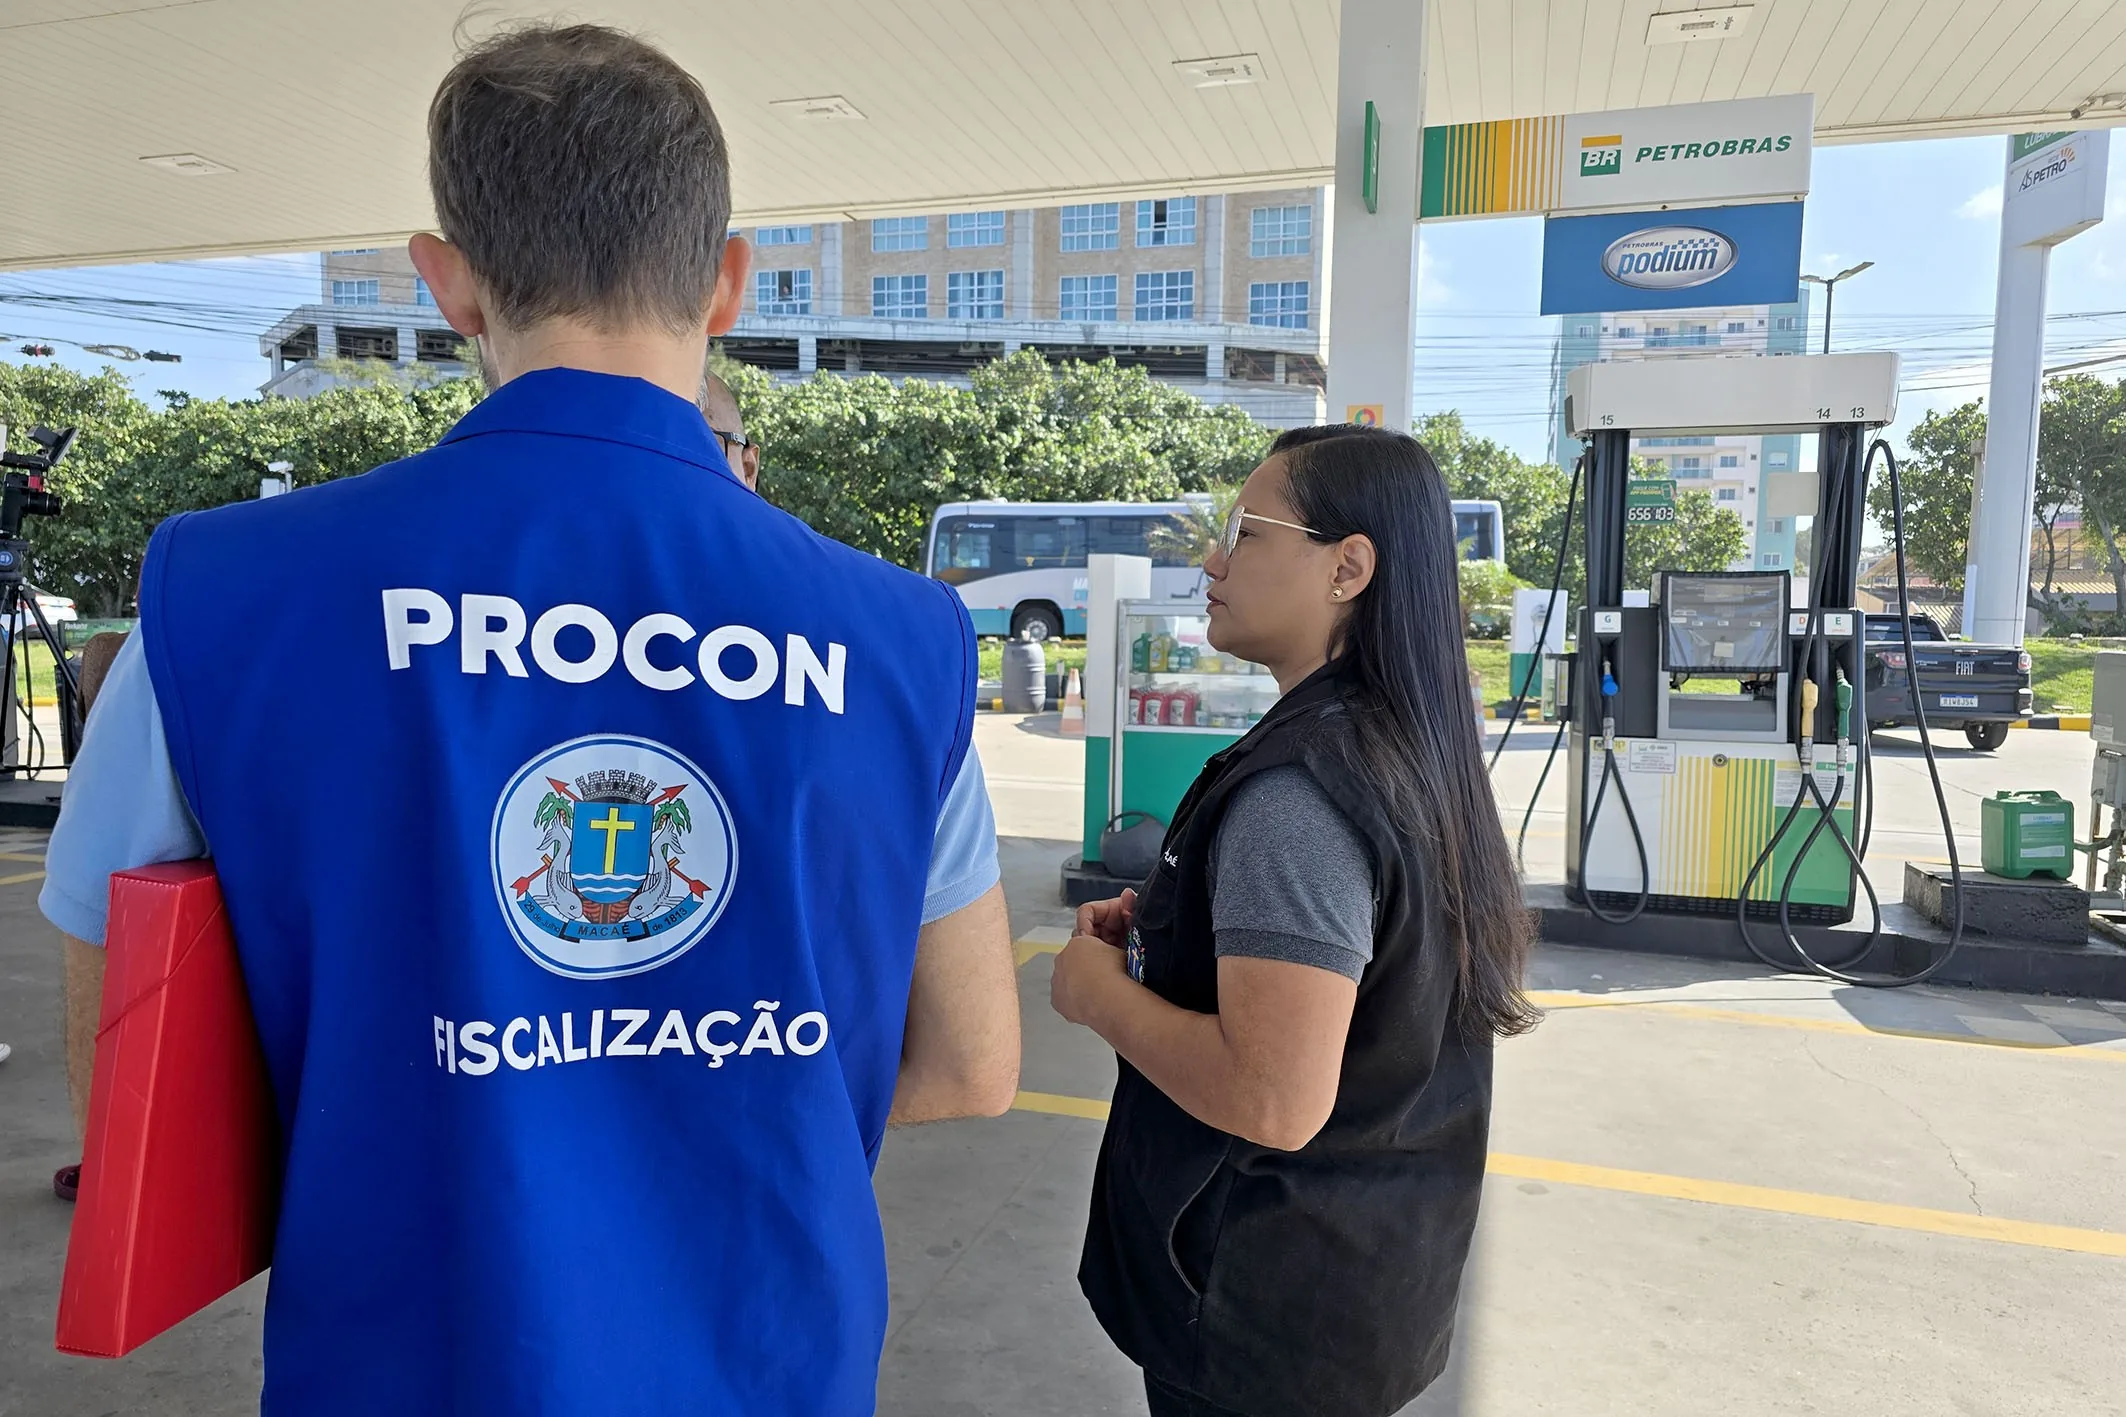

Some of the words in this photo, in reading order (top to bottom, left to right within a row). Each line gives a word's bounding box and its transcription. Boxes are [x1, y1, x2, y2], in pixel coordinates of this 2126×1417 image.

[1635, 135, 1793, 163] PETROBRAS
[1584, 149, 1617, 167] BR
[1622, 241, 1664, 249] PETROBRAS
[1616, 245, 1719, 278] podium
[1816, 408, 1831, 419] 14
[1850, 407, 1865, 418] 13
[1600, 415, 1614, 426] 15
[1604, 614, 1611, 623] G
[1835, 616, 1842, 625] E
[382, 588, 847, 715] PROCON
[1955, 661, 1975, 676] FIAT
[523, 901, 534, 914] 29
[532, 912, 542, 923] de
[652, 922, 663, 932] de
[664, 908, 688, 925] 1813
[578, 922, 630, 937] MACAÉ
[433, 1000, 829, 1076] FISCALIZAÇÃO
